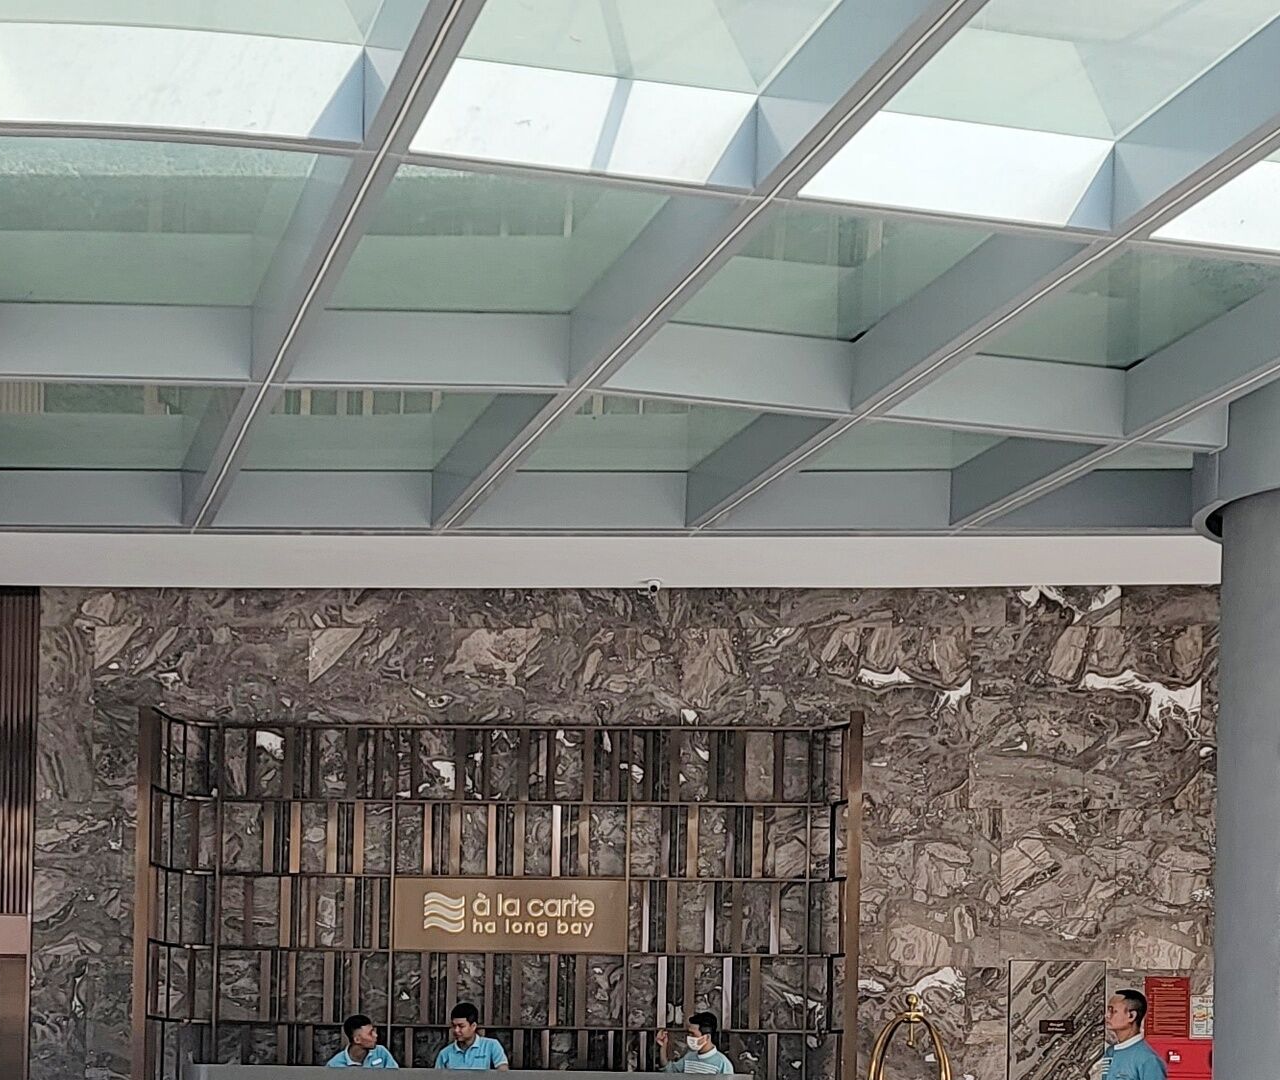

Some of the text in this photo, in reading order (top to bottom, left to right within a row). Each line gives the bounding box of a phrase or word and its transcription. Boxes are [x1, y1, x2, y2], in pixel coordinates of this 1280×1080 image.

[472, 892, 595, 918] à la carte
[472, 918, 594, 938] ha long bay
